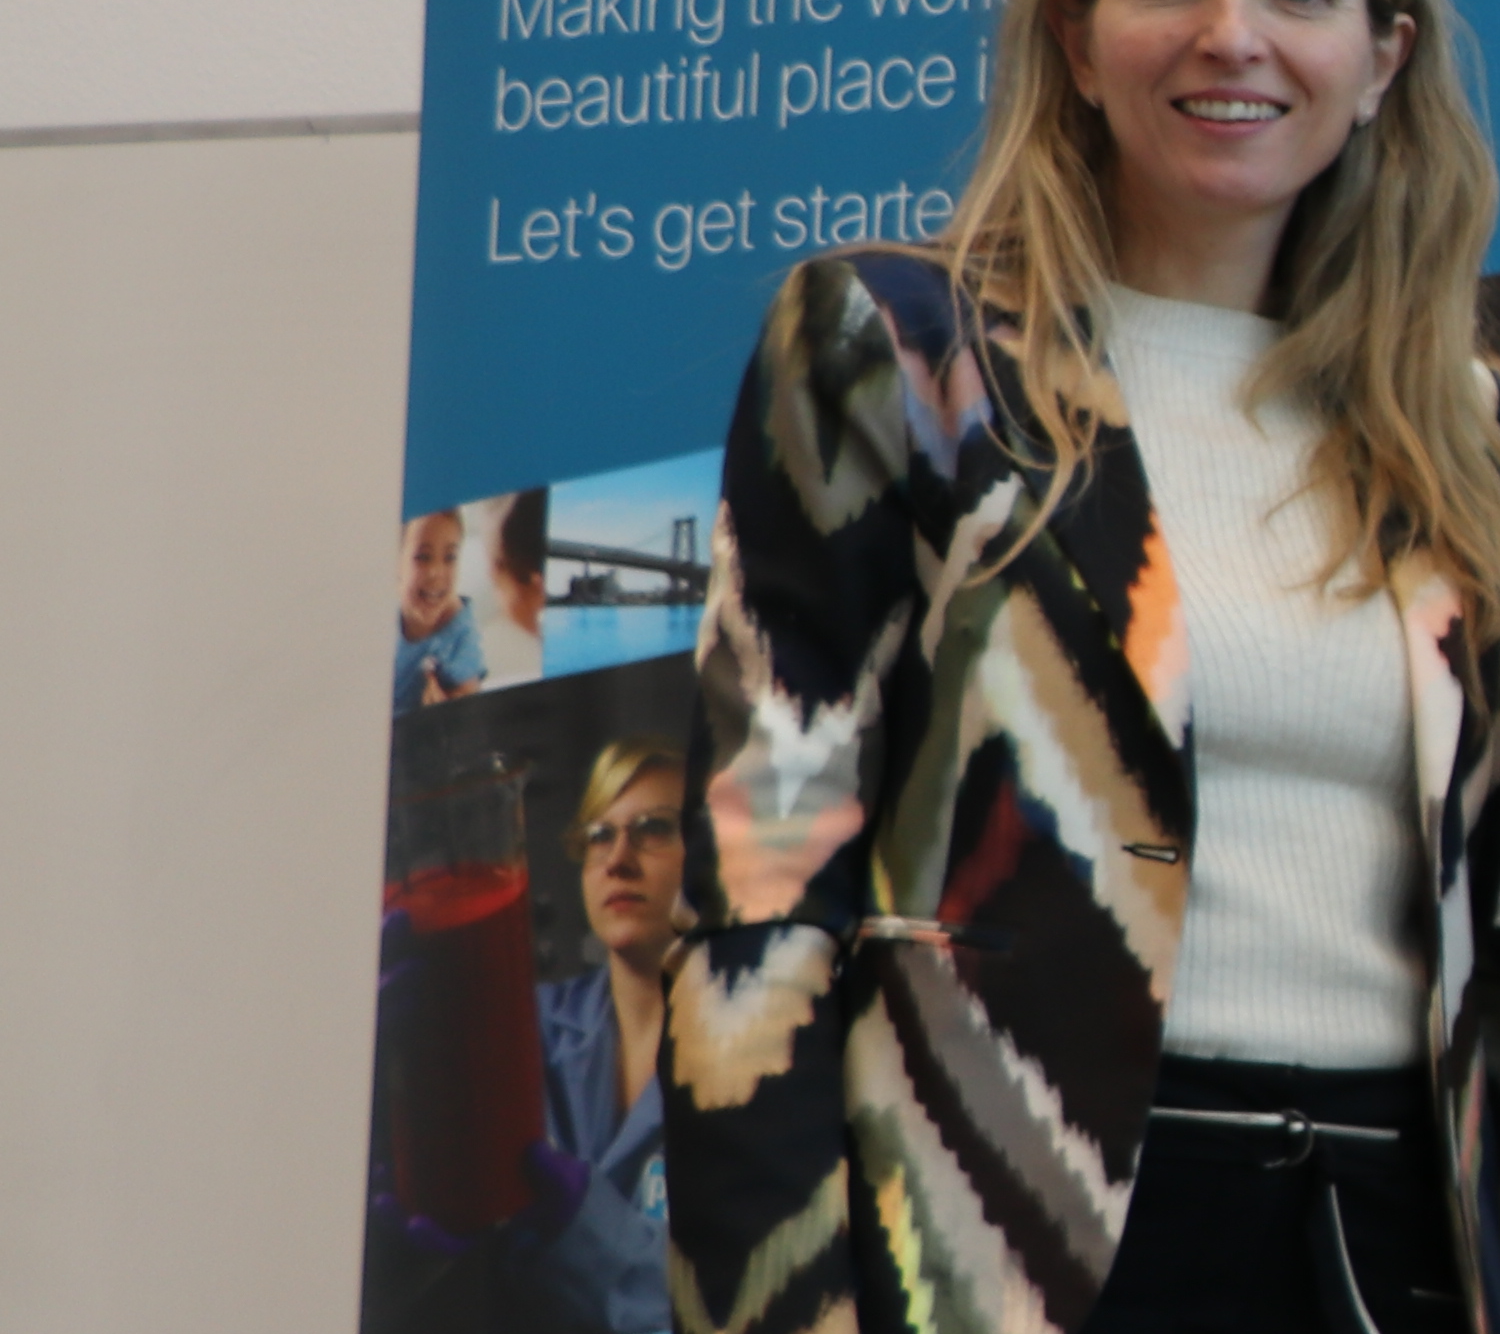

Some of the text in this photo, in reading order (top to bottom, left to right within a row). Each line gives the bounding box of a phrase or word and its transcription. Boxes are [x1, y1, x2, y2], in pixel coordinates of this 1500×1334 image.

[495, 51, 760, 133] beautiful
[779, 47, 956, 130] place
[489, 191, 635, 264] Let's
[655, 189, 756, 272] get
